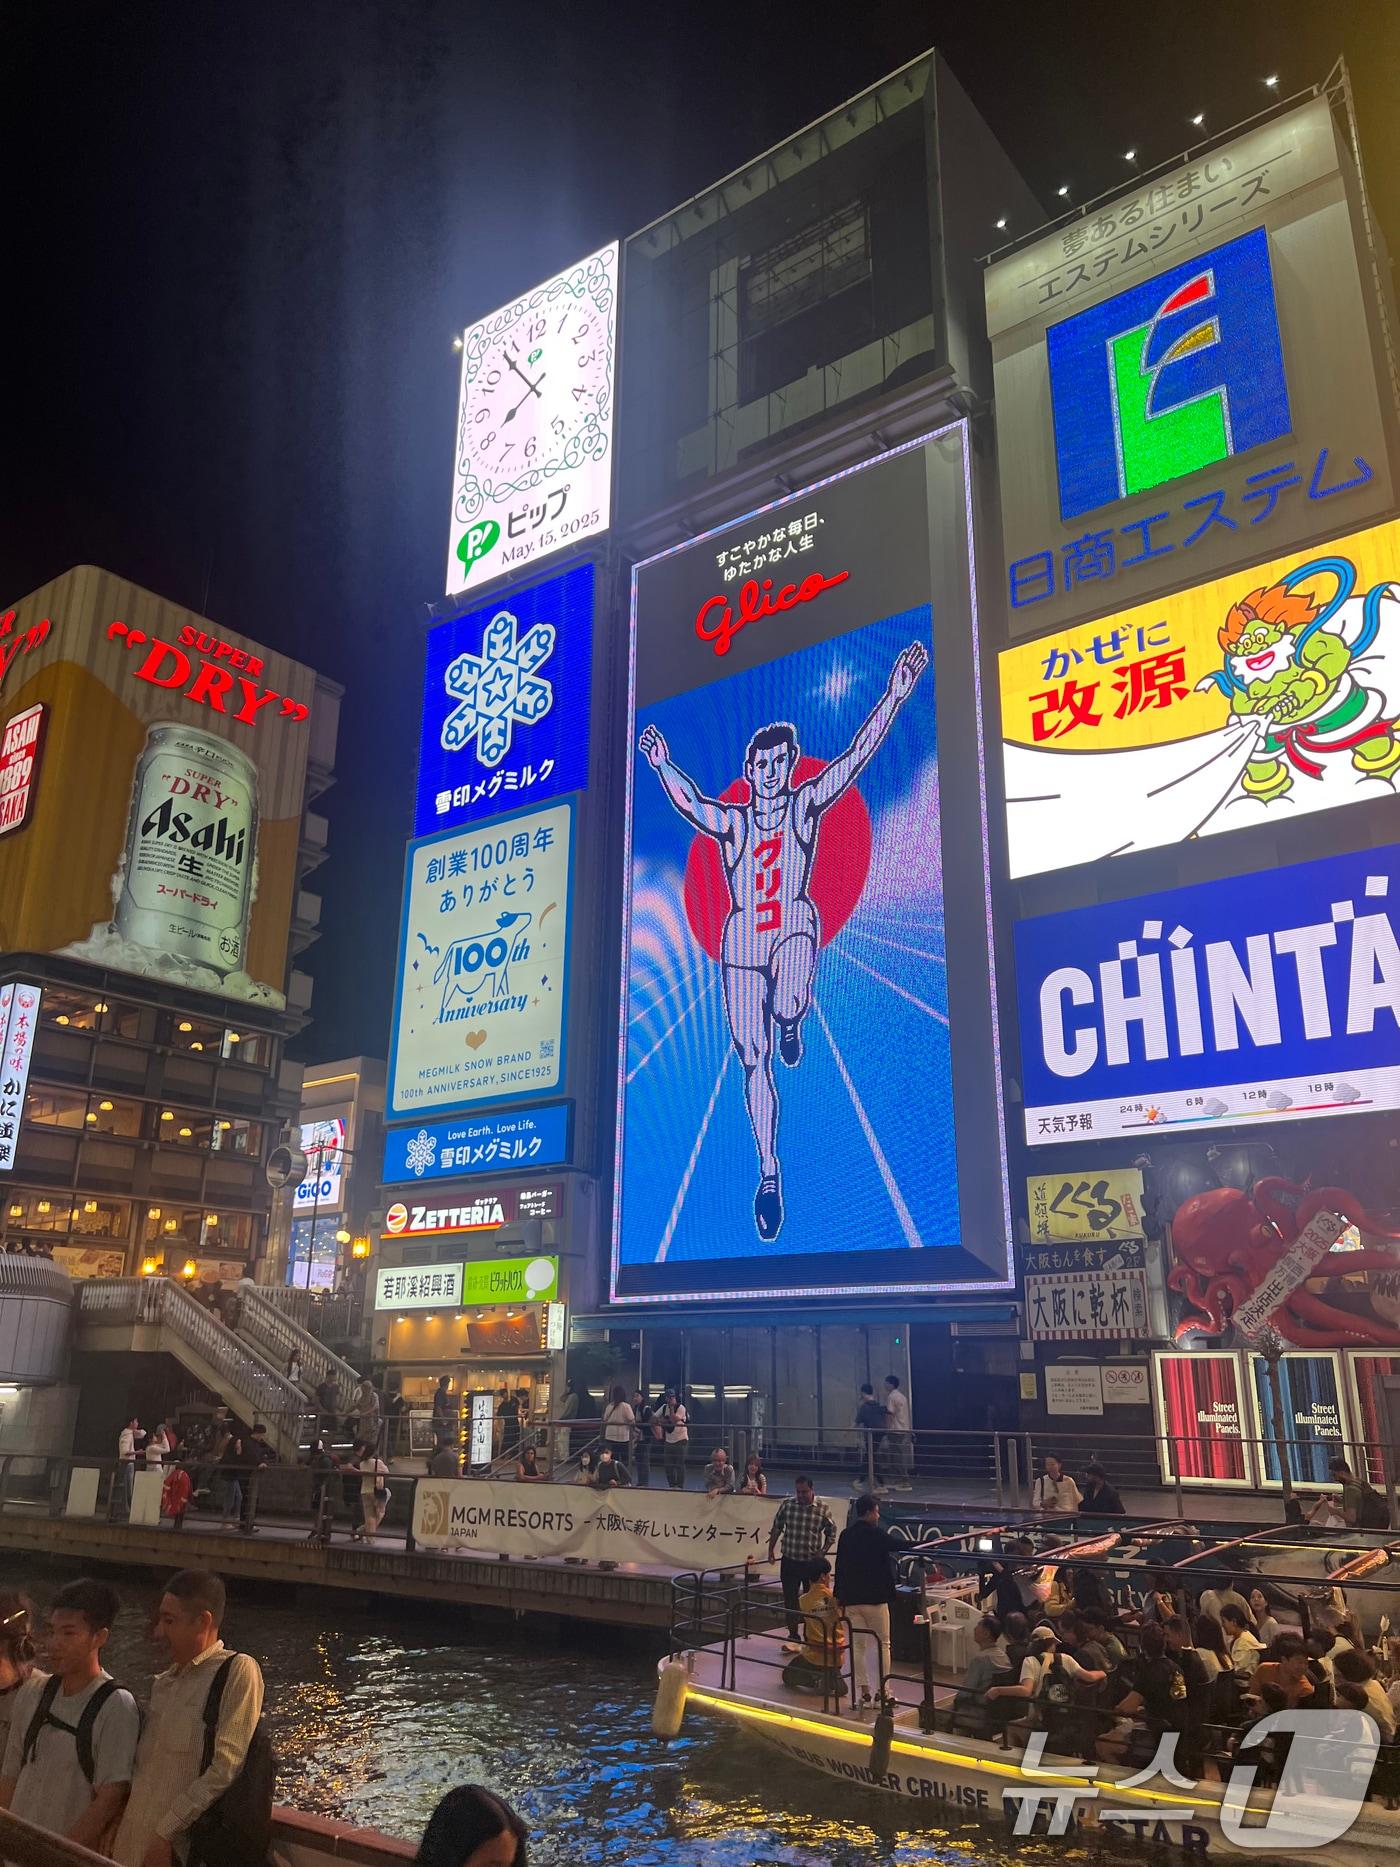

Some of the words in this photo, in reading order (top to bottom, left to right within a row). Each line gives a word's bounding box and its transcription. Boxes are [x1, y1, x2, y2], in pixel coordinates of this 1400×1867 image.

[1061, 156, 1232, 257] 夢ある住まい
[1038, 169, 1271, 304] エステムシリーズ
[526, 319, 547, 343] 12
[571, 324, 590, 345] 2
[578, 350, 596, 369] 3
[482, 369, 502, 396] 10
[571, 385, 588, 403] 4
[550, 416, 565, 435] 5
[480, 432, 496, 451] 8
[498, 443, 515, 463] 7
[524, 437, 537, 457] 6
[507, 484, 571, 538] ピップ
[560, 508, 600, 538] 2025
[1008, 448, 1373, 608] 日商エステム
[722, 534, 815, 583] ゆたかな人生
[177, 625, 265, 678] SUPER
[1041, 620, 1170, 681] かぜに
[1028, 646, 1191, 741] 改源
[3, 713, 41, 755] ASAHI
[185, 769, 222, 789] SUPER
[435, 758, 556, 815] 雪印メグミルク
[141, 797, 246, 866] Asahi
[178, 854, 204, 877] 生
[425, 826, 555, 885] 創業100周年
[439, 867, 536, 914] ありがとう
[752, 831, 784, 933] グリコ
[157, 884, 218, 910] スーパードライ
[220, 936, 240, 958] お酒
[433, 993, 528, 1025] Anniversary
[9, 1012, 30, 1072] 本場の味
[419, 1064, 460, 1079] MEGMILK
[464, 1058, 493, 1072] SNOW
[496, 1051, 532, 1066] BRAND
[401, 1088, 423, 1099] 100th
[1120, 1103, 1143, 1114] 24時
[1186, 1096, 1204, 1107] 6時
[1242, 1089, 1267, 1101] 12時
[1308, 1081, 1334, 1093] 18時
[448, 1130, 466, 1140] Love
[468, 1125, 493, 1138] Earth.
[497, 1120, 516, 1134] Love
[518, 1119, 537, 1131] Life.
[1037, 1112, 1094, 1135] 天気予報
[440, 1136, 542, 1168] 雪印メグミルク
[410, 1203, 505, 1231] ZETTERIA
[1050, 1180, 1122, 1231] くくる
[1032, 1282, 1129, 1329] 大阪に乾杯
[1240, 1280, 1284, 1329] 出店決定
[1213, 1402, 1235, 1413] Street
[1312, 1403, 1335, 1414] Street
[1216, 1423, 1241, 1434] Panels.
[1315, 1426, 1343, 1436] Panels.
[451, 1506, 491, 1525] MGM
[494, 1508, 573, 1531] RESORTS
[451, 1527, 477, 1538] JAPAN
